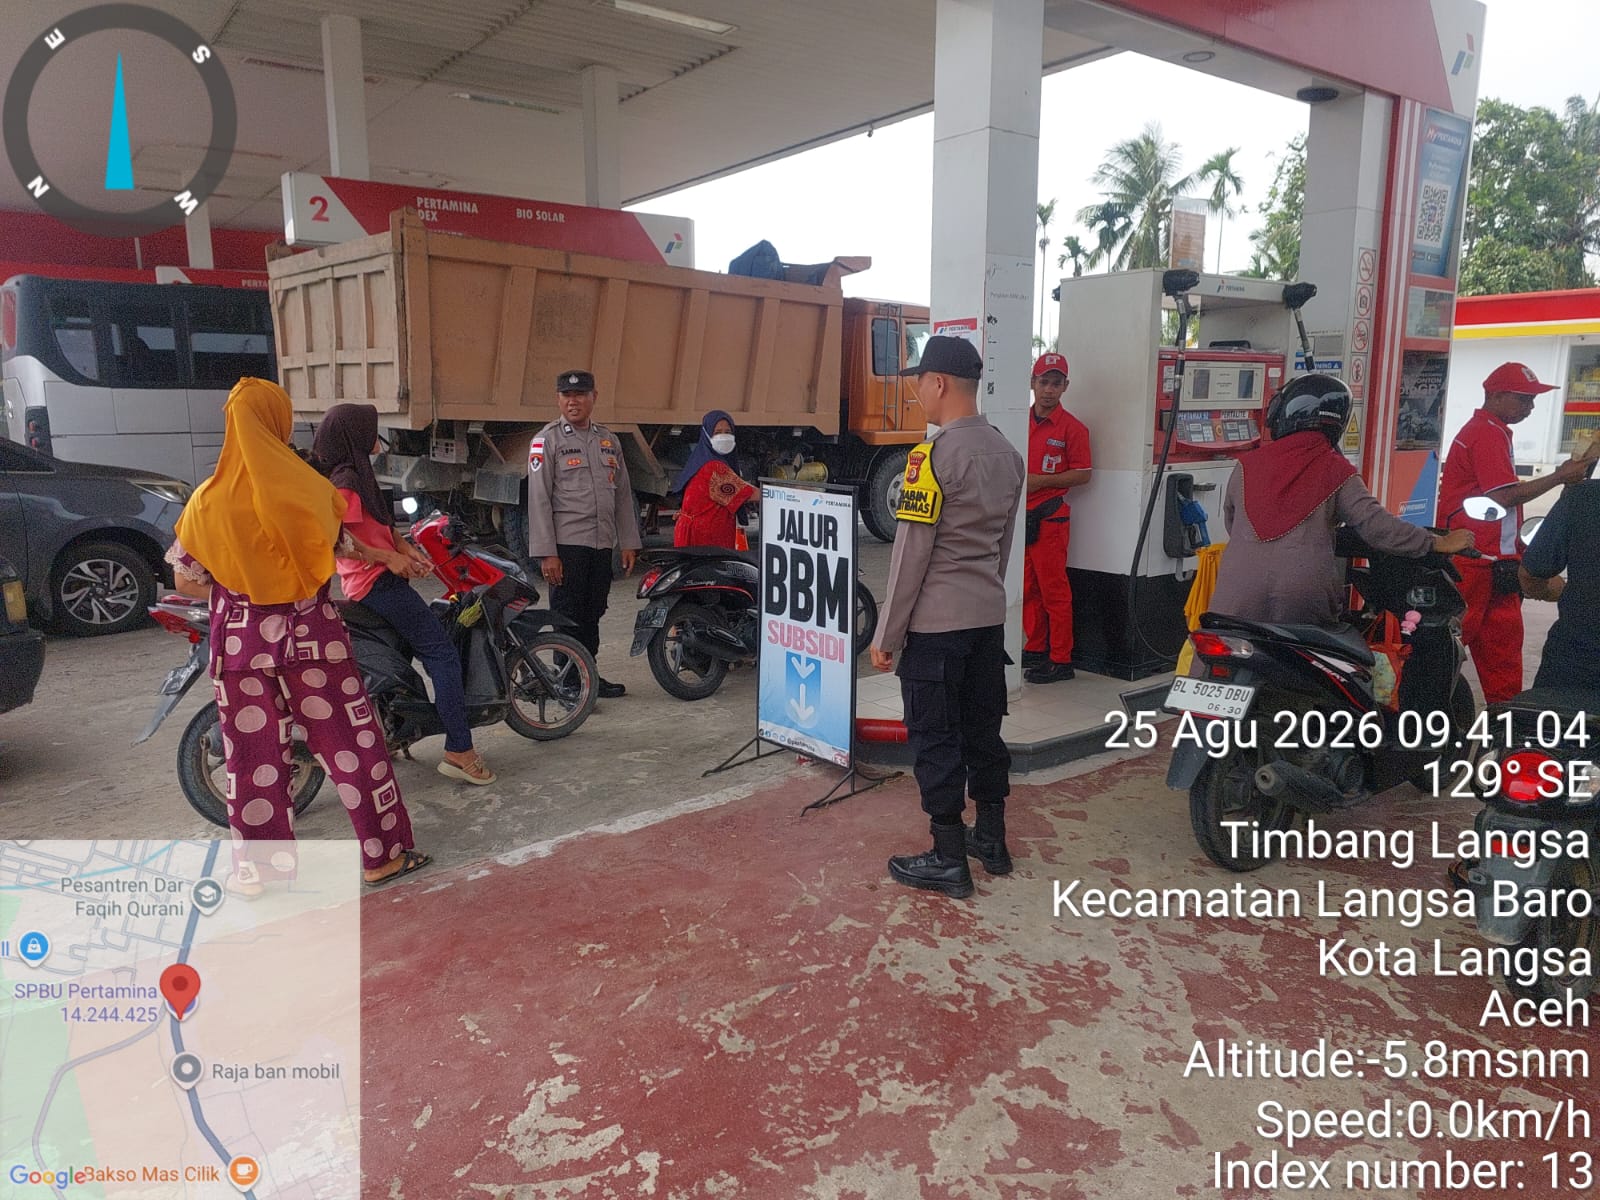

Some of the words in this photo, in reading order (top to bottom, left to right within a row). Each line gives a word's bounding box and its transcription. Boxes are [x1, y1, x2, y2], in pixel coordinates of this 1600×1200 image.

[309, 195, 329, 222] 2
[416, 196, 479, 214] PERTAMINA
[418, 209, 438, 222] DEX
[516, 208, 533, 219] BIO
[535, 210, 565, 223] SOLAR
[241, 279, 269, 288] PERTA
[777, 508, 838, 551] JALUR
[765, 543, 849, 634] BBM
[767, 619, 845, 664] SUBSIDI
[1173, 680, 1187, 693] BL
[1193, 683, 1224, 699] 5025
[1225, 688, 1250, 703] DBU
